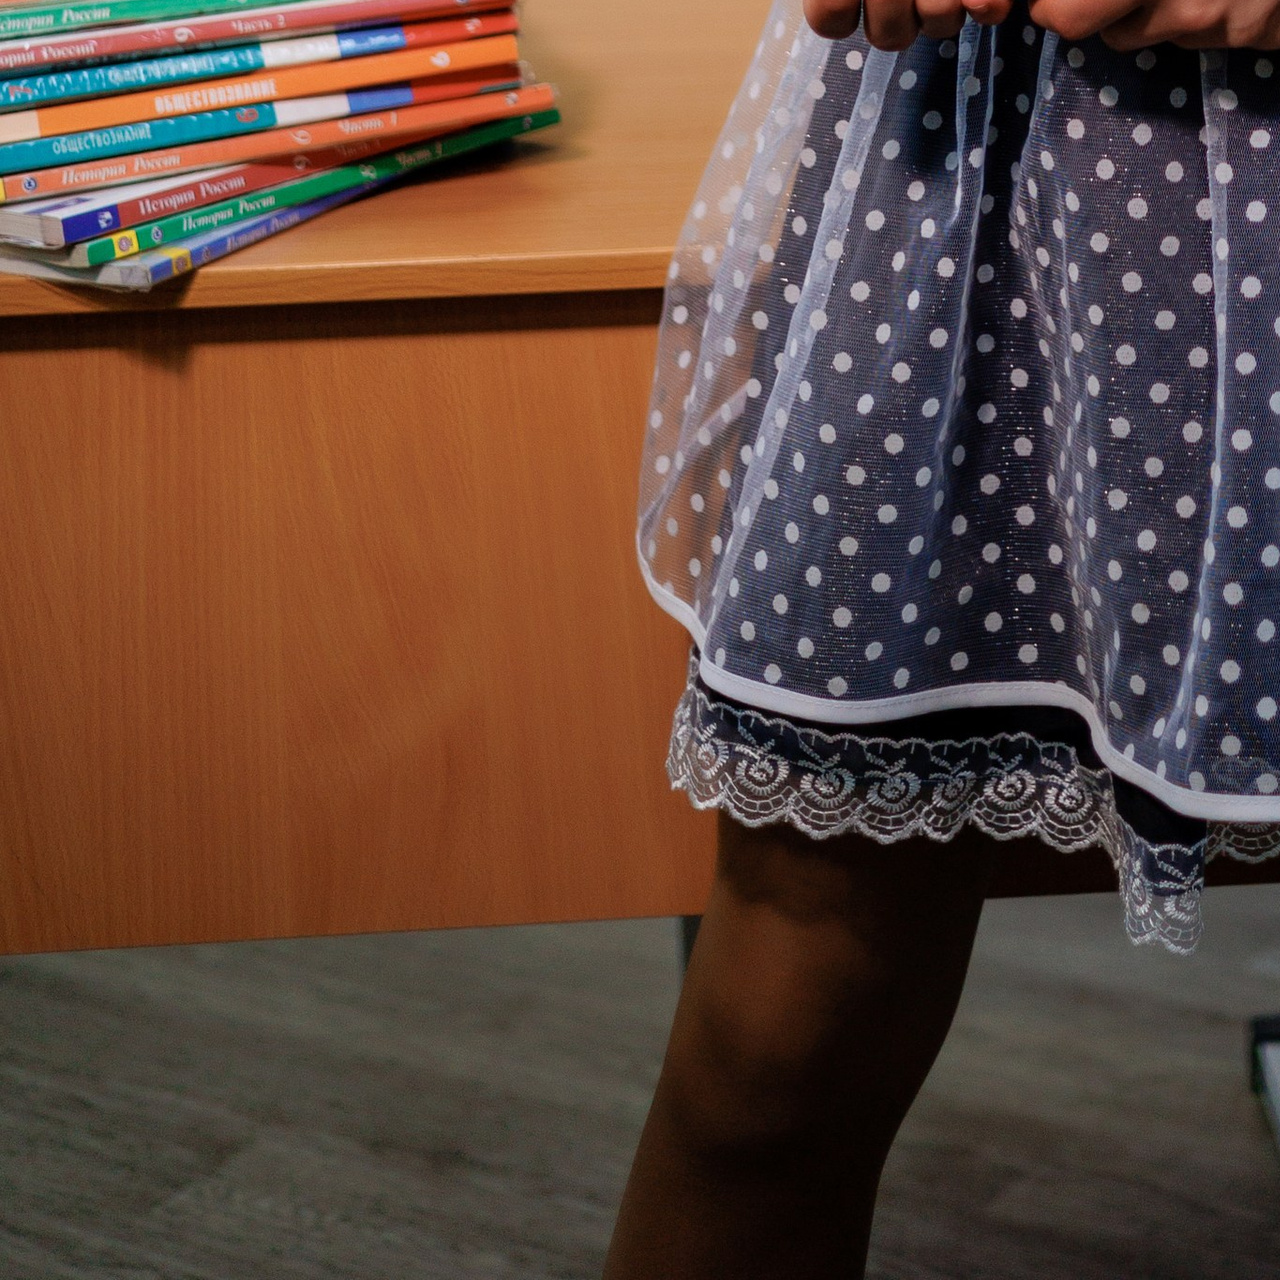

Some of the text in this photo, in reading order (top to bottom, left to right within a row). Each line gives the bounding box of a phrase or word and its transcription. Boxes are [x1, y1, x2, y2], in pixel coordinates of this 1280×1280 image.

[62, 6, 111, 25] России
[154, 78, 278, 114] ОБЩЕСТВОЗНАНИЕ
[52, 124, 153, 155] ОБЩЕСТВОЗНАНИЕ
[60, 163, 127, 186] История
[133, 153, 182, 172] России
[138, 192, 196, 216] История
[199, 174, 246, 199] России
[182, 208, 234, 233] История
[238, 192, 276, 214] России
